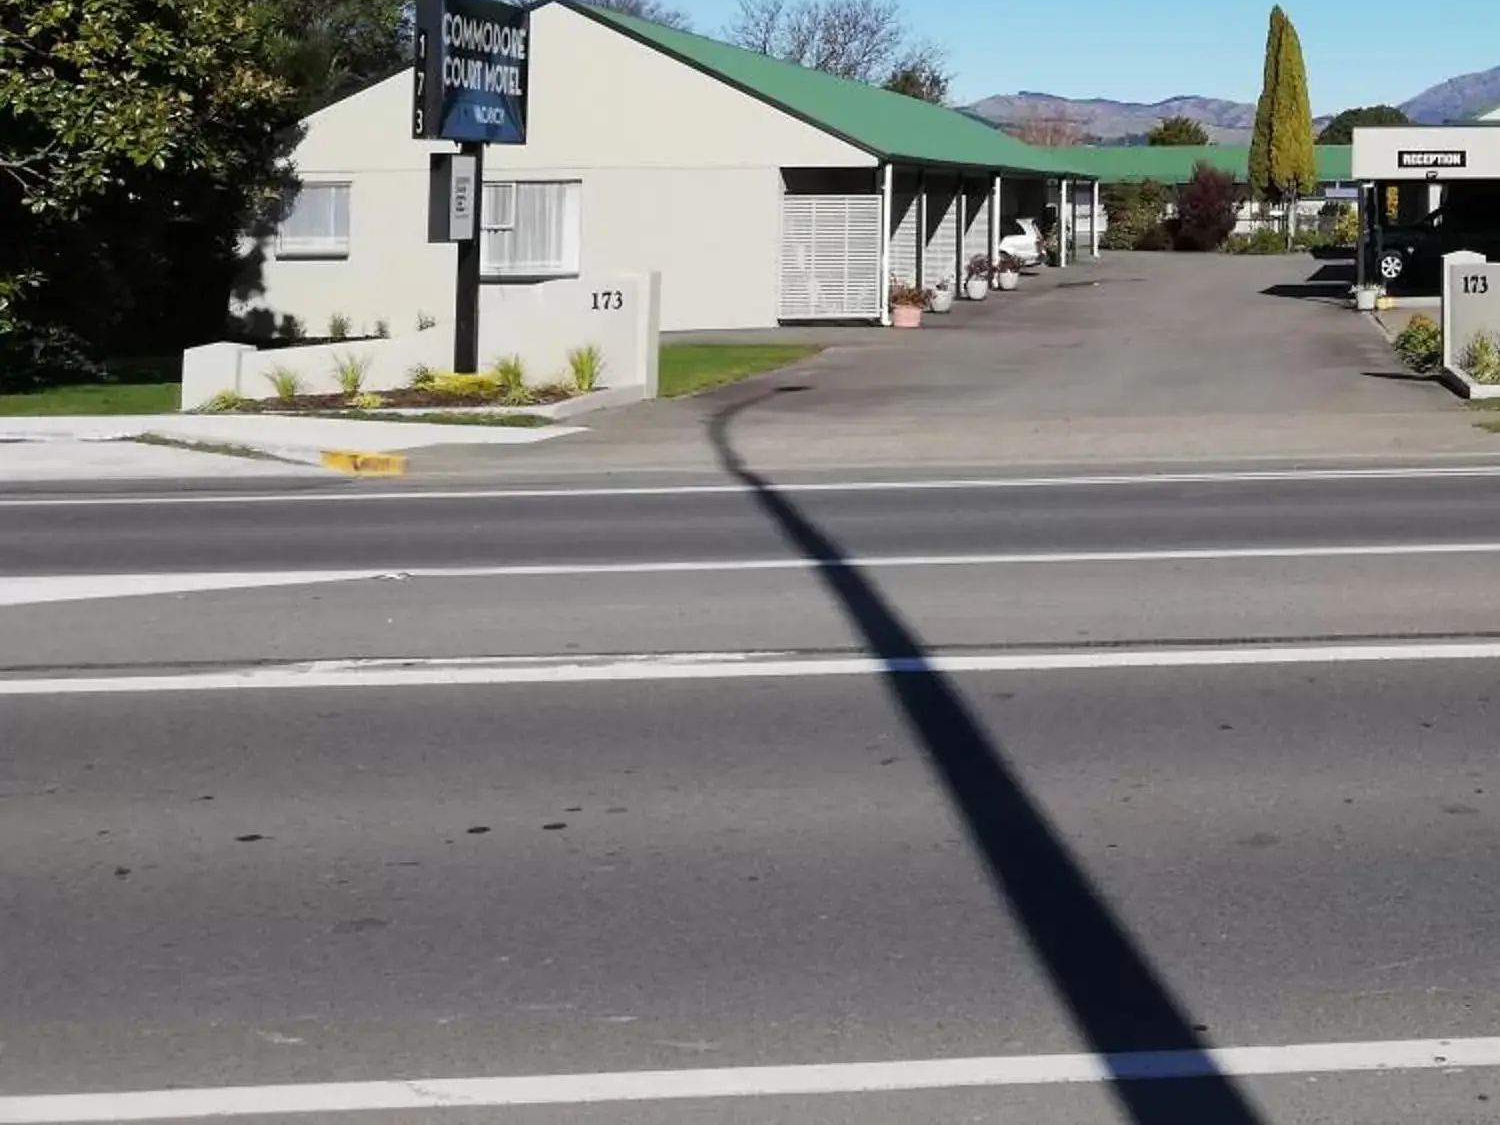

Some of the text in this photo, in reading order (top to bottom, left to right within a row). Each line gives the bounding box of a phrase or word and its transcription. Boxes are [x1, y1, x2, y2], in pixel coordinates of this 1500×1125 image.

[442, 13, 527, 59] COMMODORE
[442, 56, 523, 96] COURT MOTEL
[1403, 153, 1461, 166] RECEPTION
[1463, 275, 1489, 294] 173
[591, 290, 623, 310] 173
